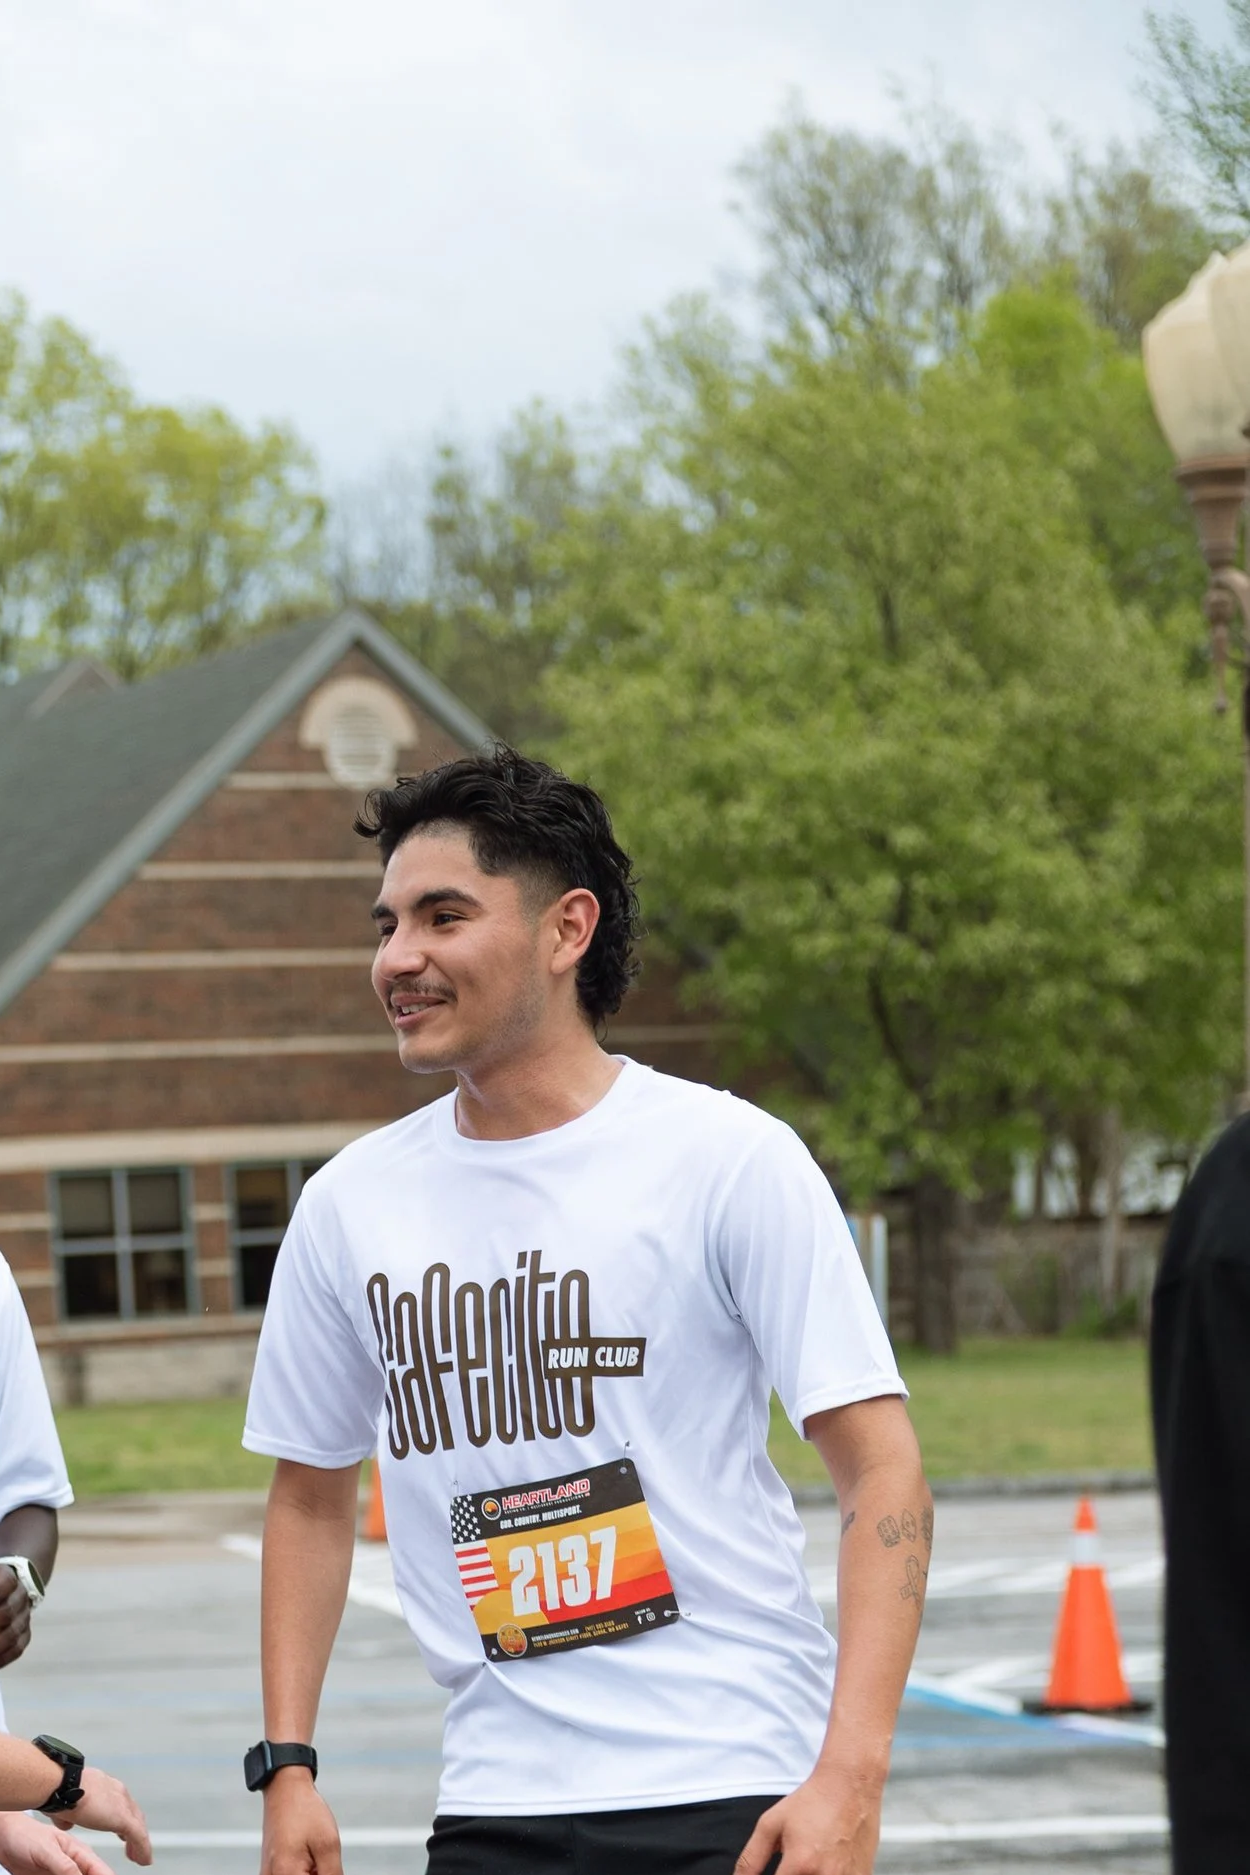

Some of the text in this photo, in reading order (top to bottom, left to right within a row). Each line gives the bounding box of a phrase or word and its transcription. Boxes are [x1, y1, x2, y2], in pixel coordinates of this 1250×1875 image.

[547, 1346, 640, 1369] RUN CLUB
[502, 1479, 590, 1510] HEARTLAND
[508, 1525, 617, 1617] 2137
